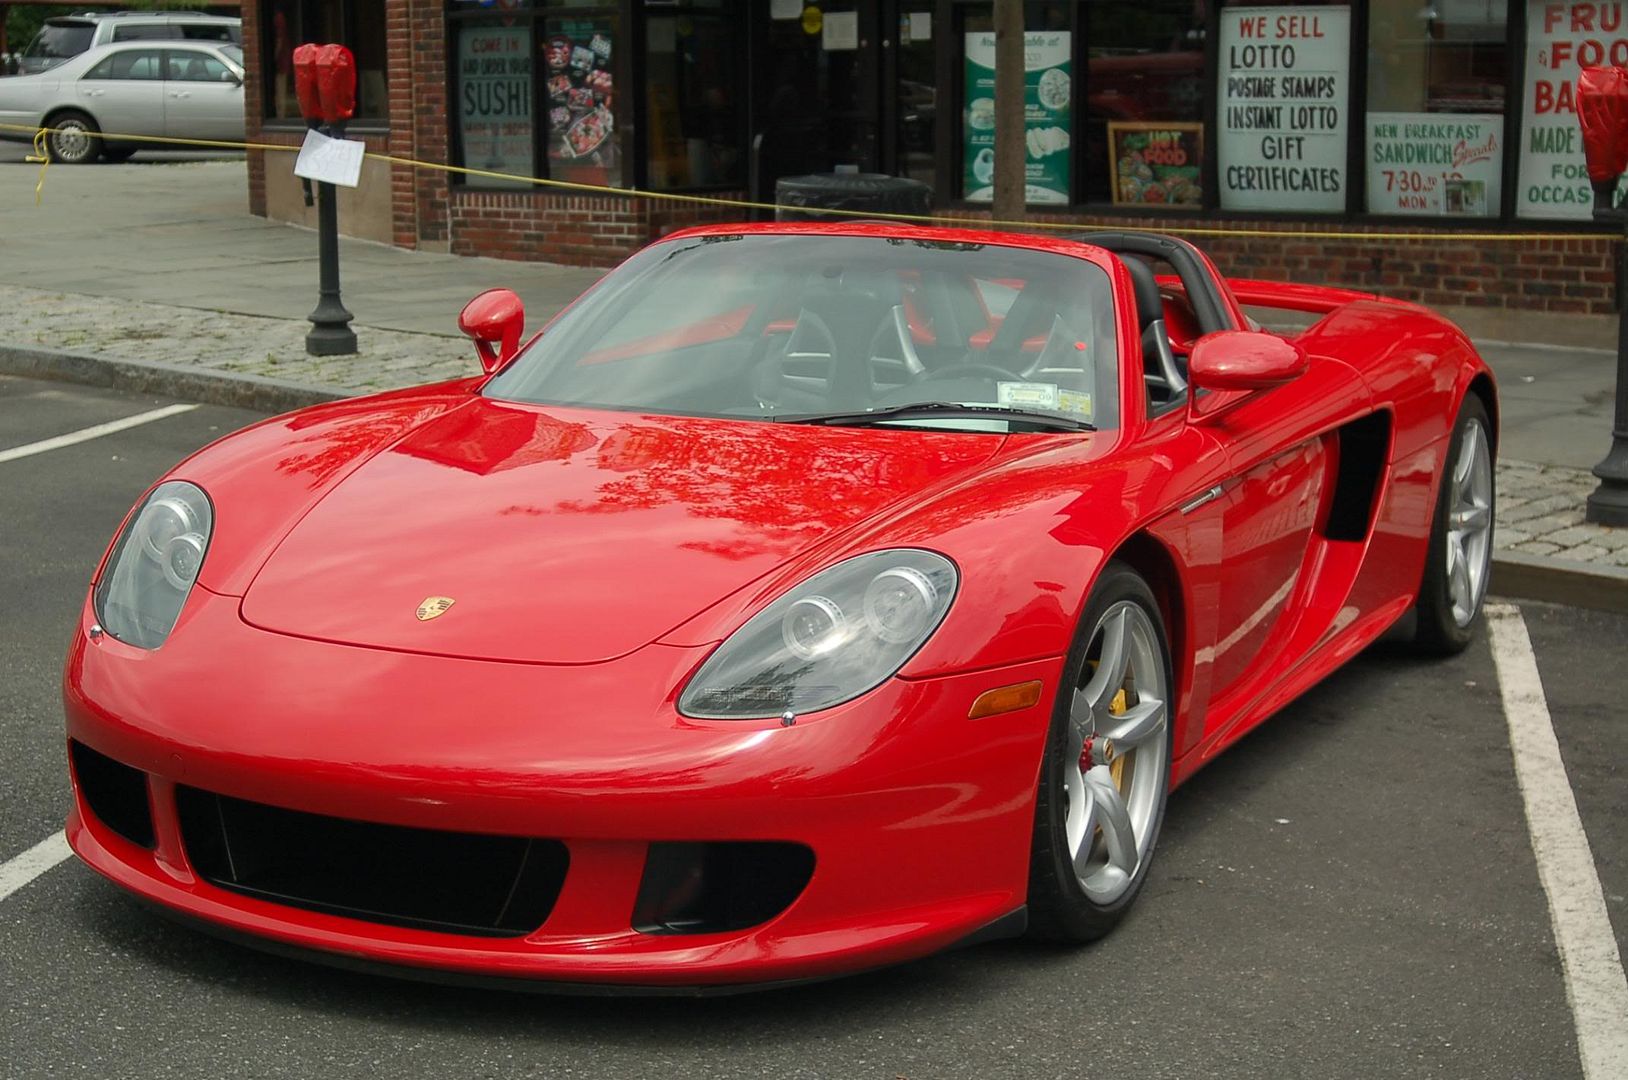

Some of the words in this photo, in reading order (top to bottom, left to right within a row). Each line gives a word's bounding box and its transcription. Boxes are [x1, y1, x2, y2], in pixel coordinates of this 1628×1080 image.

[1239, 16, 1267, 38] WE
[1275, 15, 1324, 38] SELL
[472, 37, 501, 53] COME
[506, 37, 519, 51] IN
[1230, 44, 1296, 70] LOTTO
[464, 80, 529, 116] SUSHI
[1227, 76, 1276, 98] POSTAGE
[1281, 76, 1335, 98] STAMPS
[1227, 106, 1282, 130] INSTANT
[1290, 106, 1338, 130] LOTTO
[1149, 130, 1182, 149] HOT
[1374, 124, 1398, 138] NEW
[1404, 123, 1481, 140] BREAKFAST
[1530, 126, 1575, 154] MADE
[1143, 147, 1188, 166] FOOD
[1261, 135, 1305, 160] GIFT
[1374, 141, 1453, 164] SANDWICH
[1227, 164, 1340, 193] CERTIFICATES
[1398, 195, 1427, 209] MON
[1528, 185, 1628, 205] OCCAS
